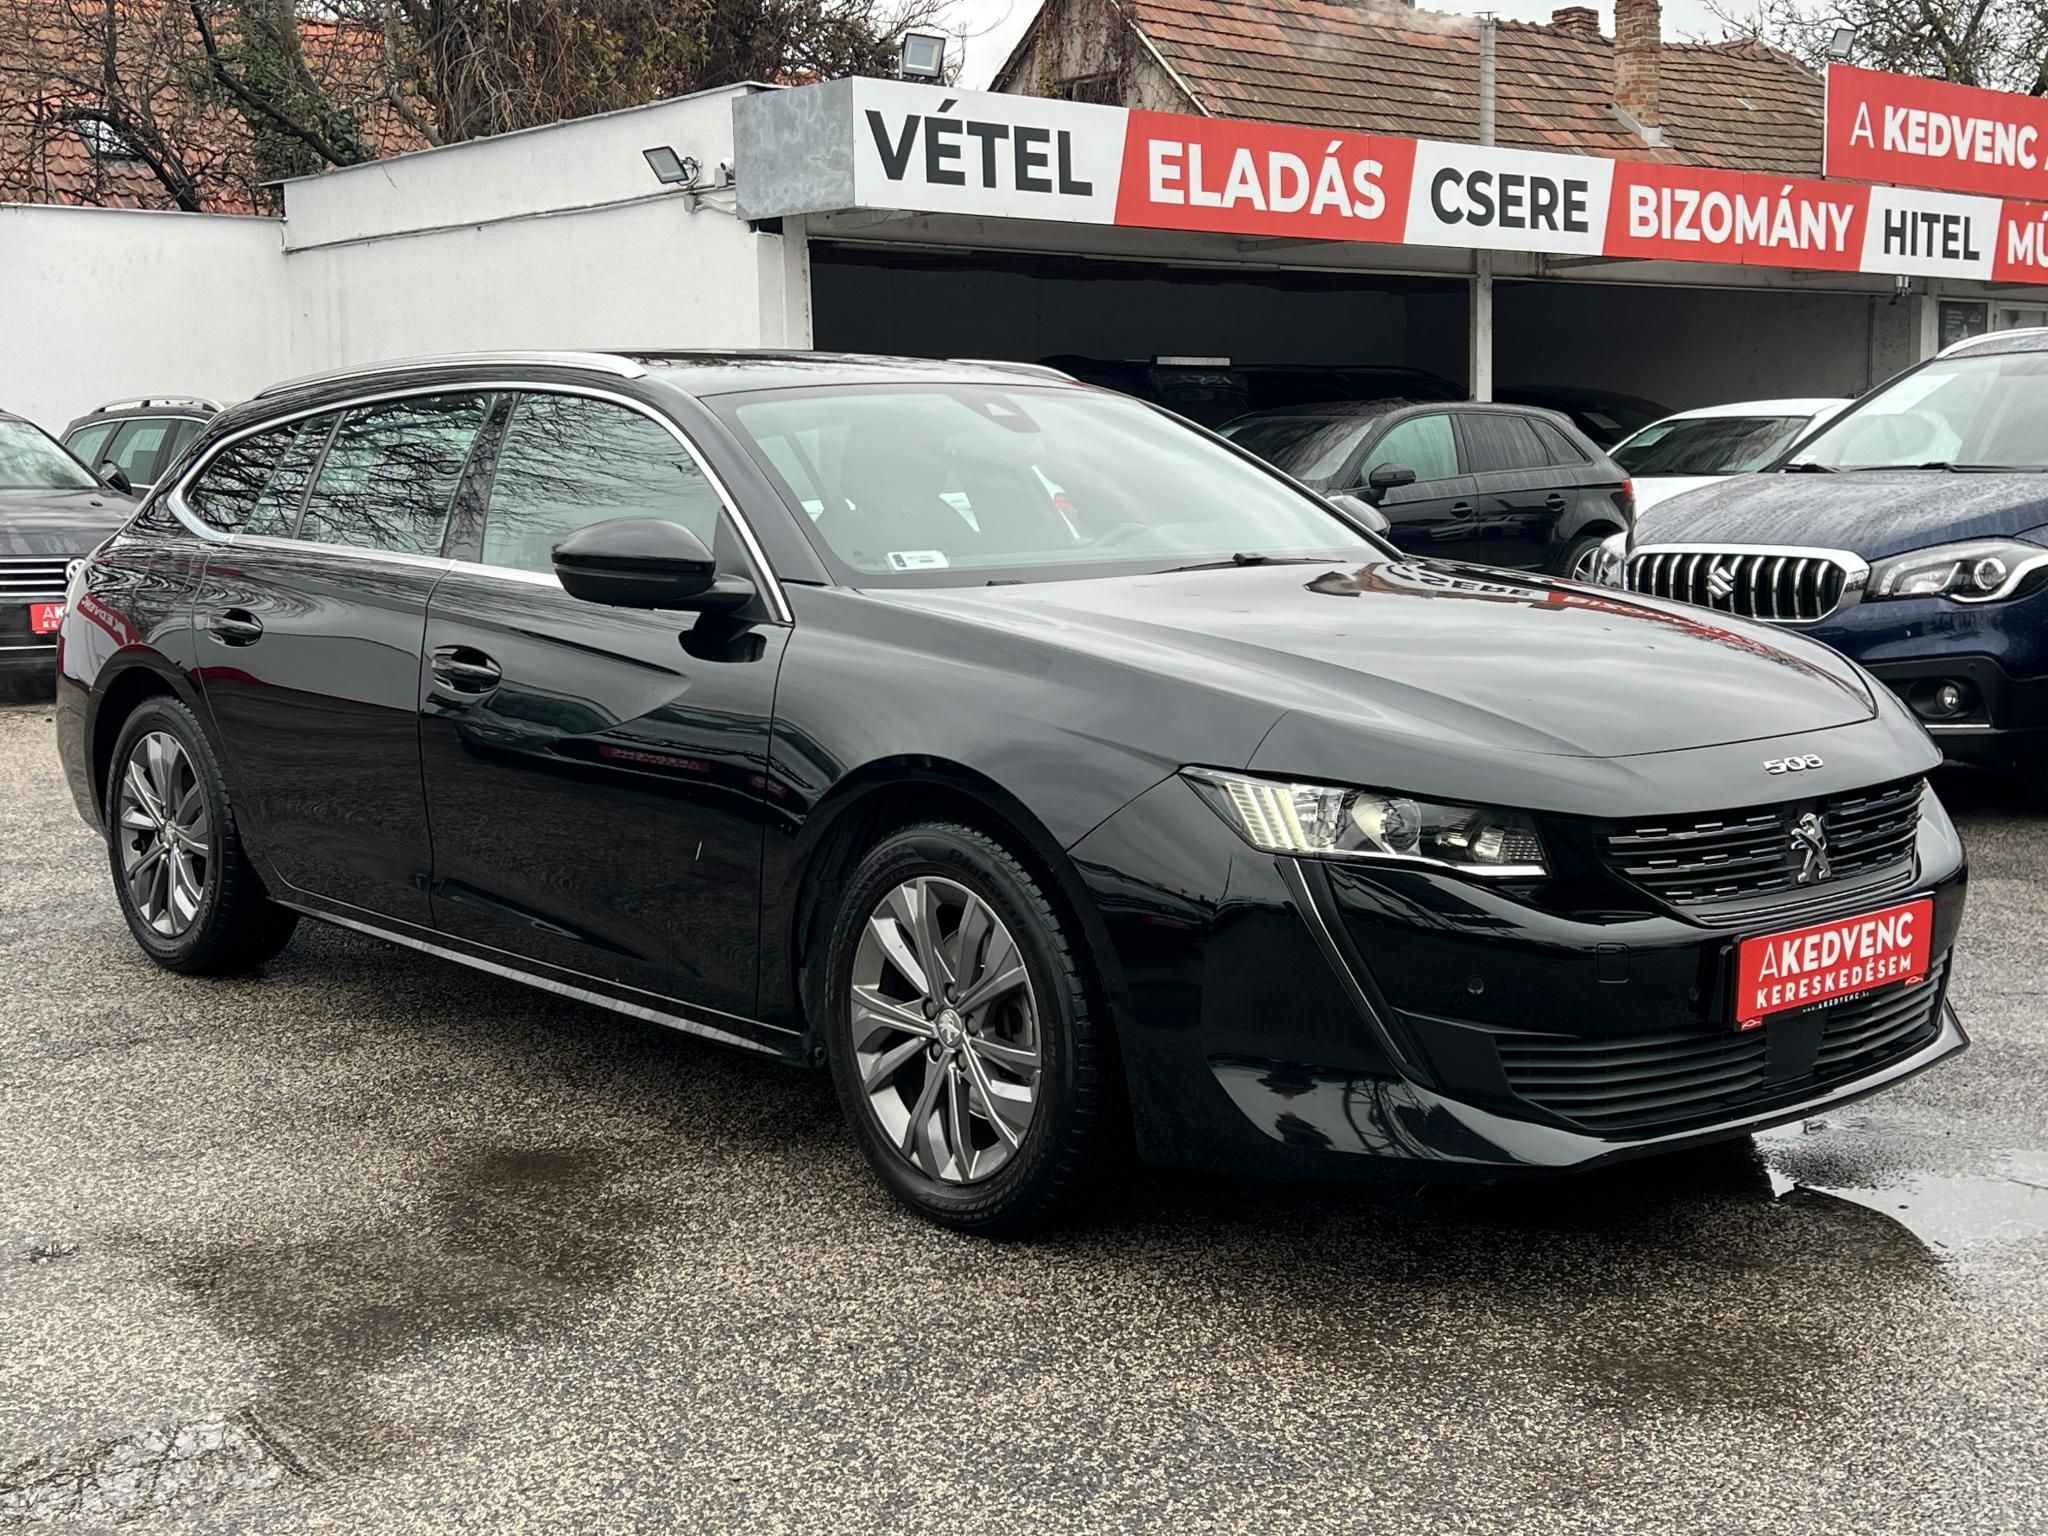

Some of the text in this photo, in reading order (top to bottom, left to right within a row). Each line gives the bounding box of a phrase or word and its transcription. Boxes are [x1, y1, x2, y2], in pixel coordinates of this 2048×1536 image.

[1850, 101, 2039, 170] A KEDVENC
[865, 99, 1093, 197] VÉTEL
[1148, 140, 1385, 220] ELADÁS
[1431, 167, 1590, 234] CSERE
[1629, 185, 1854, 252] BIZOMÁNY
[1884, 209, 1980, 261] HITEL
[1763, 754, 1824, 775] 508
[1756, 952, 1912, 1010] KERESKEDÉSEM
